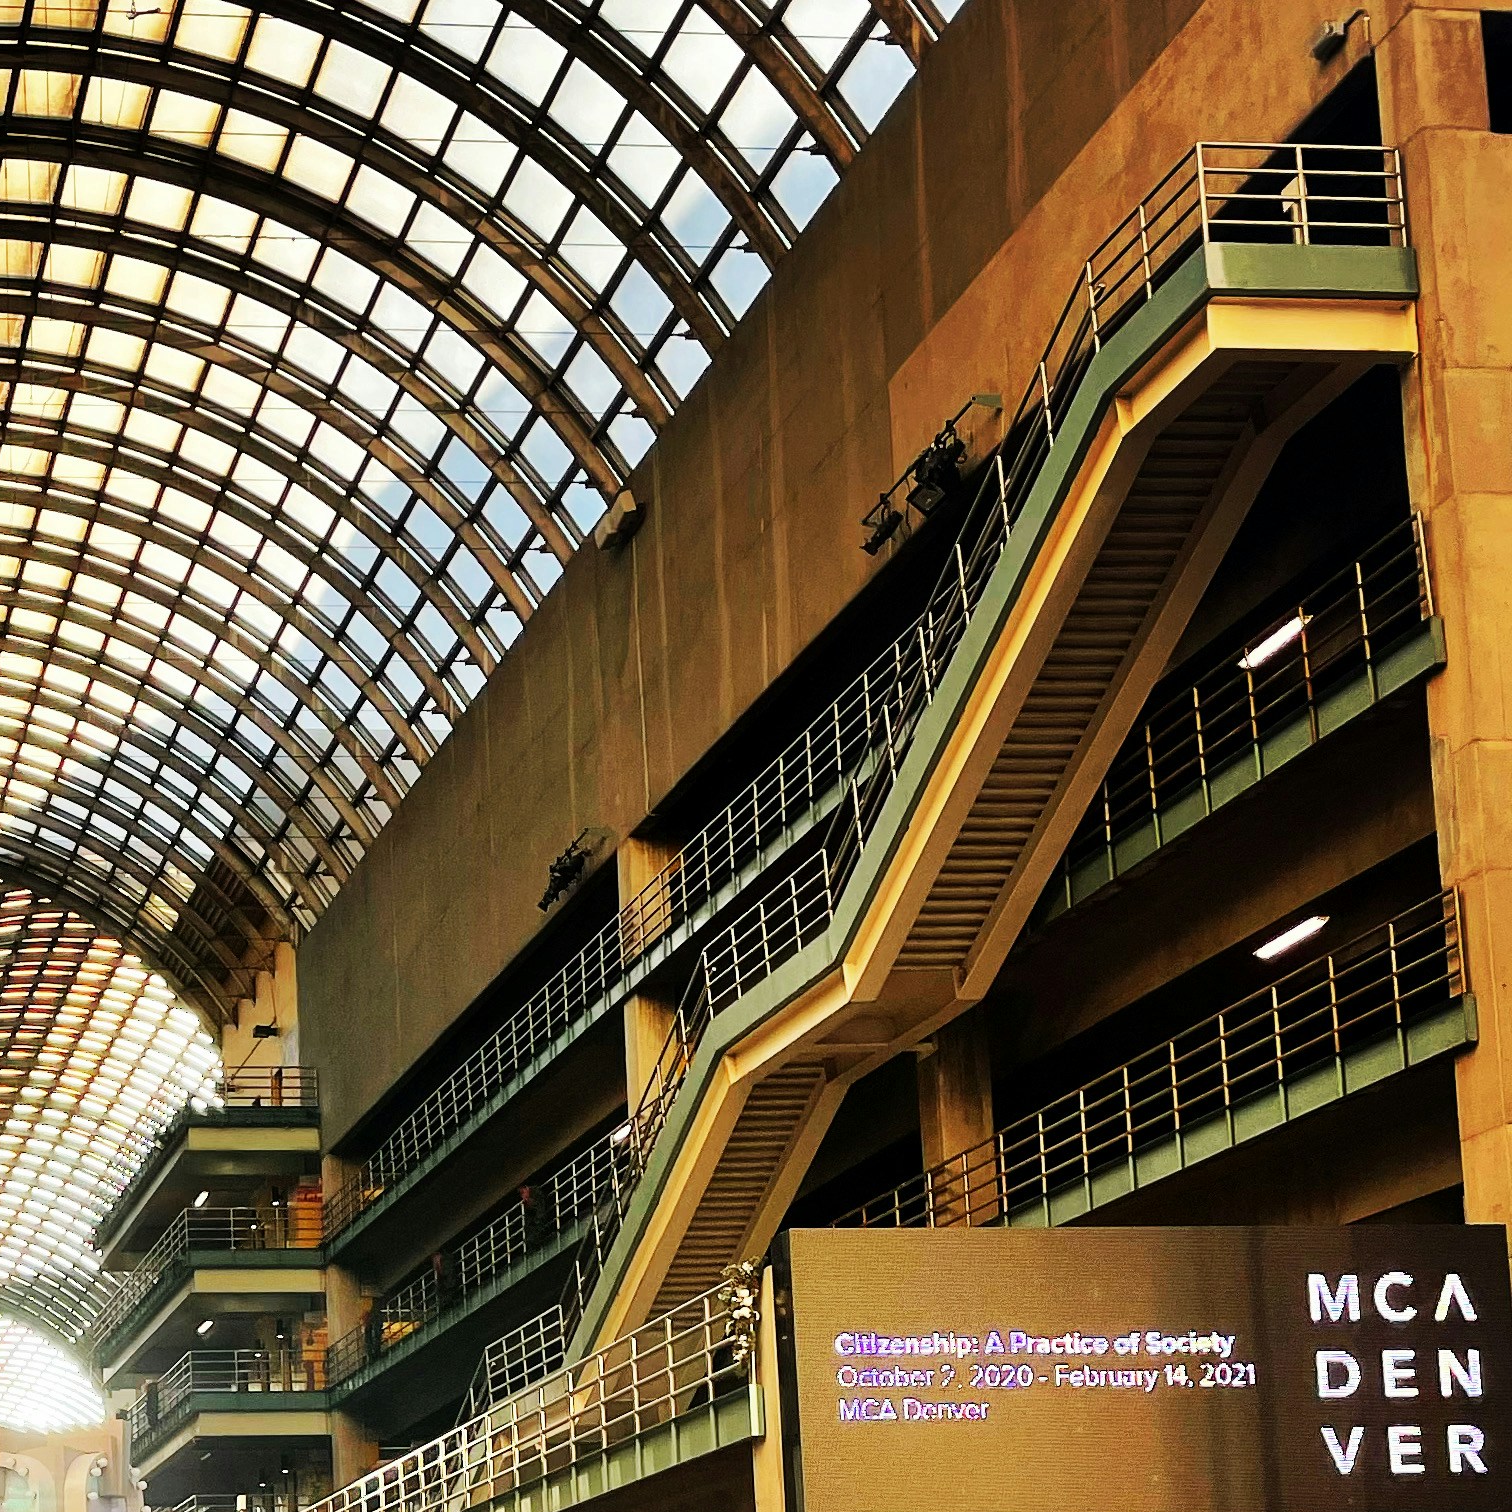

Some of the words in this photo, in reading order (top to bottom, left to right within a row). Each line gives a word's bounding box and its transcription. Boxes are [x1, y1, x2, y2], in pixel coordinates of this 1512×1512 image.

[1308, 1271, 1478, 1323] MCA
[834, 1331, 979, 1358] Citizenship:
[985, 1331, 1005, 1354] A
[1010, 1331, 1109, 1355] Practice
[1114, 1331, 1140, 1355] of
[1145, 1331, 1236, 1359] Society
[836, 1364, 934, 1387] October
[969, 1364, 1033, 1387] 2020
[1054, 1364, 1157, 1392] February
[1164, 1364, 1194, 1388] 14,
[1198, 1363, 1257, 1387] 2021
[1315, 1348, 1483, 1398] DEN
[839, 1398, 897, 1421] MCA
[902, 1398, 990, 1421] Denver
[1321, 1424, 1488, 1475] VER
